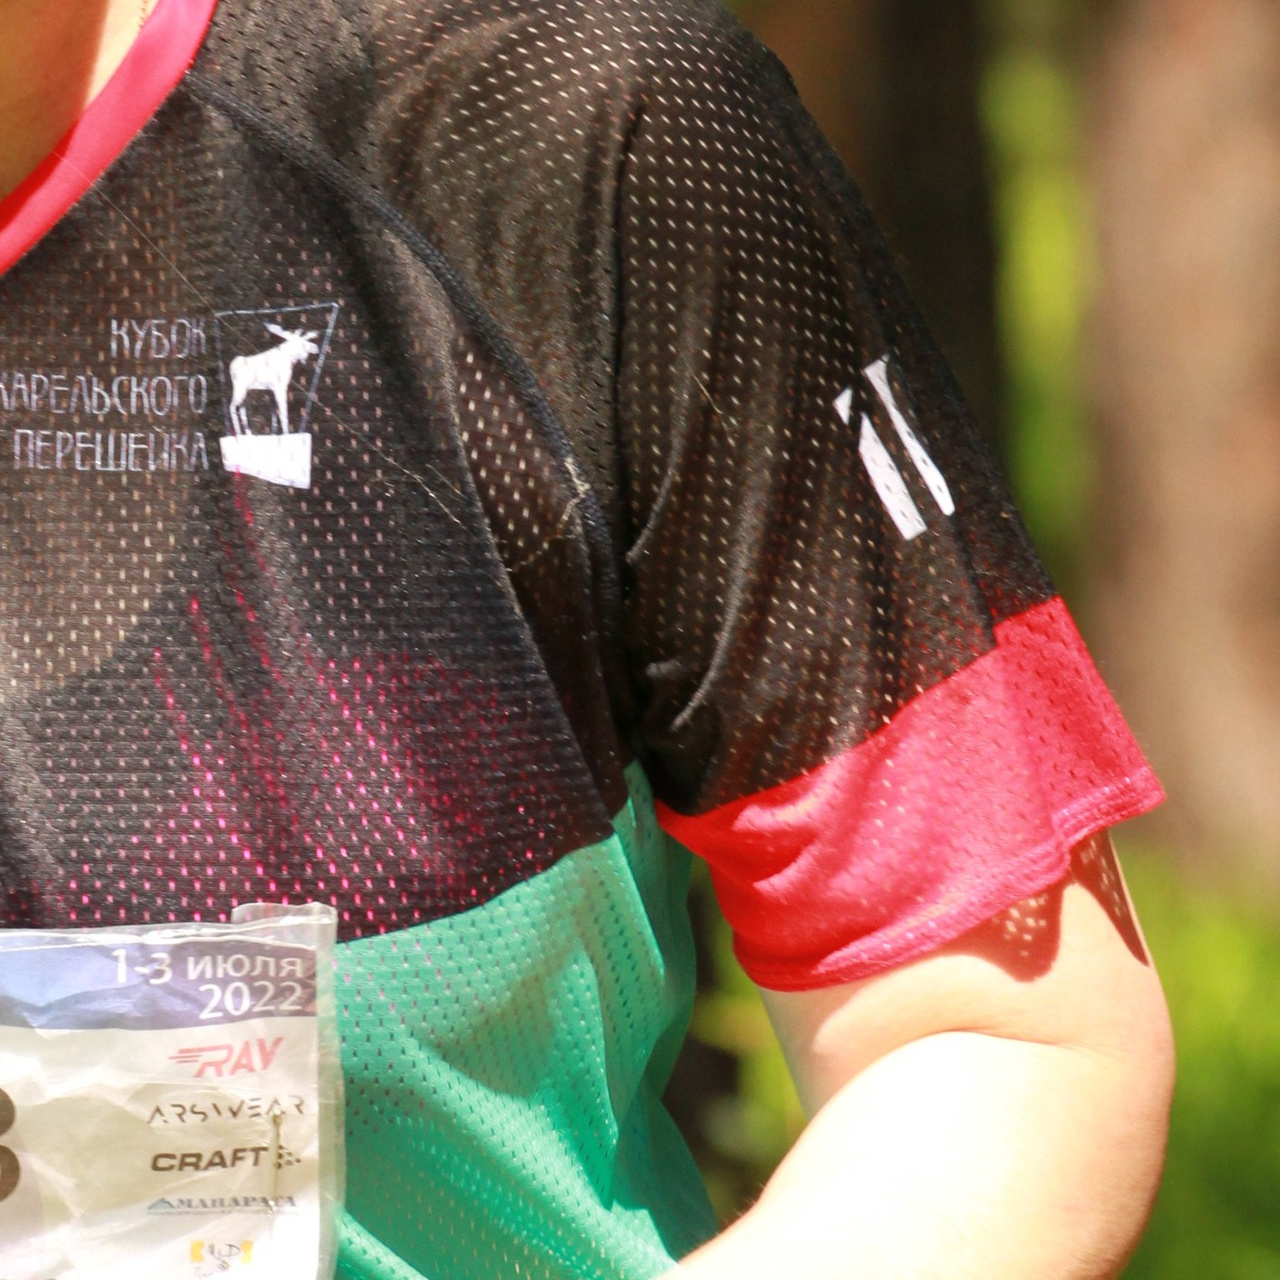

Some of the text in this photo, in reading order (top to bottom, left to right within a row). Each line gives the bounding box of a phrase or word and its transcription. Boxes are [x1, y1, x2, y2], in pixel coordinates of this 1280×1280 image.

[110, 318, 207, 359] КУБОК
[14, 424, 210, 471] ПЕРЕШЕЙКА
[110, 948, 174, 985] 1-3
[198, 980, 303, 1020] 2022
[150, 1145, 269, 1172] CRAFT
